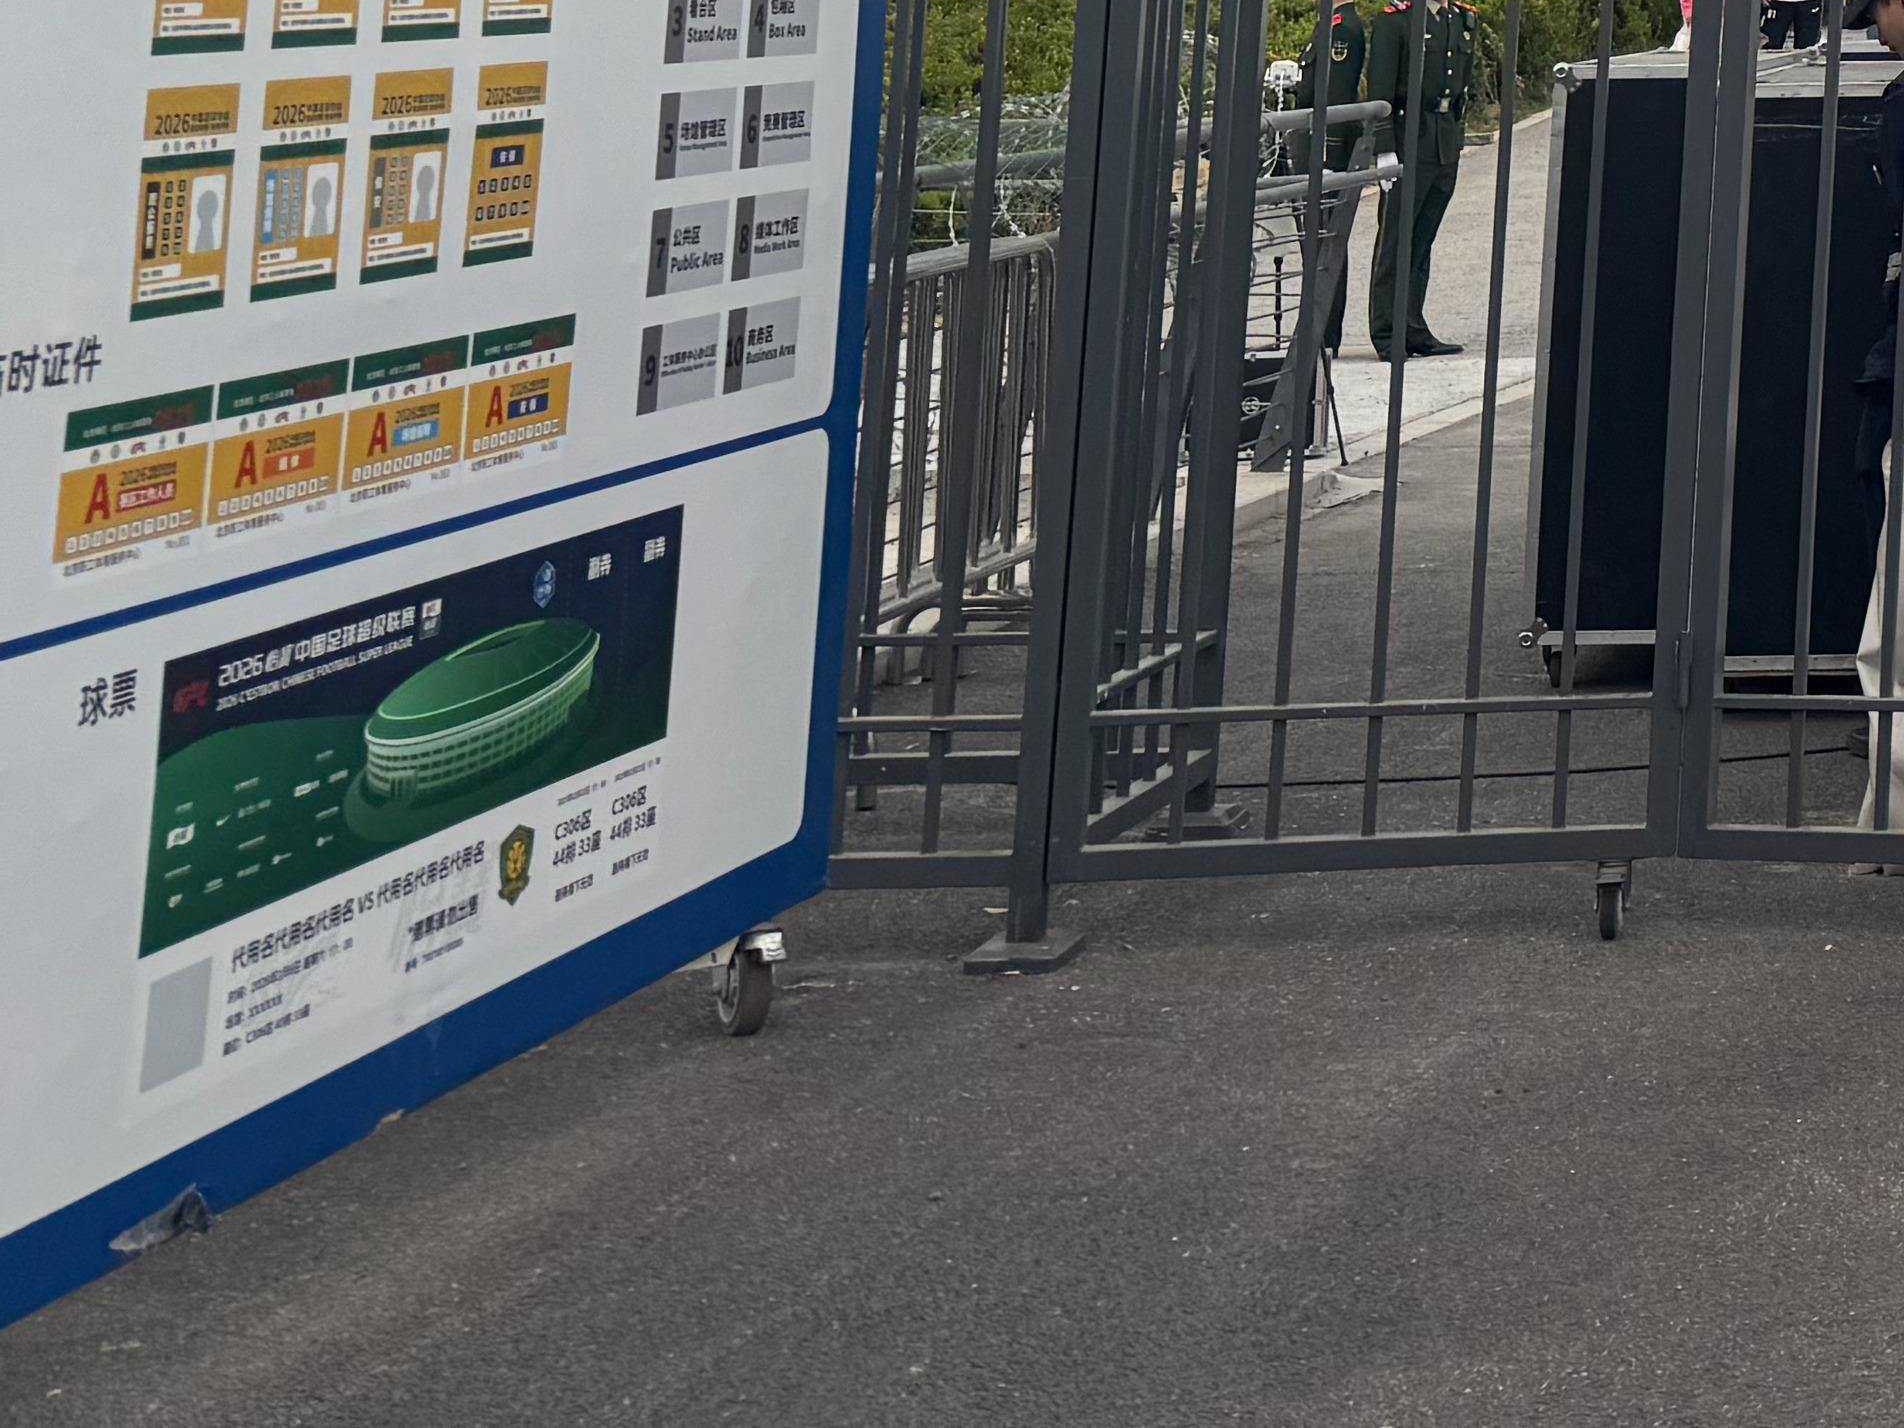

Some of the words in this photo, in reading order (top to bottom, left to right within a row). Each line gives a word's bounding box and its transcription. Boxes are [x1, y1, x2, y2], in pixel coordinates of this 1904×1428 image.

[672, 5, 684, 37] 3
[716, 25, 737, 41] Area
[754, 3, 765, 33] 4
[786, 22, 806, 38] Area
[663, 122, 674, 154] 5
[747, 114, 757, 143] 6
[656, 237, 666, 269] 7
[739, 223, 750, 254] 8
[670, 252, 701, 273] Public
[702, 251, 724, 268] Area
[0, 334, 102, 396] 时证件
[644, 354, 656, 386] 9
[78, 669, 138, 727] 球票
[357, 891, 375, 915] VS
